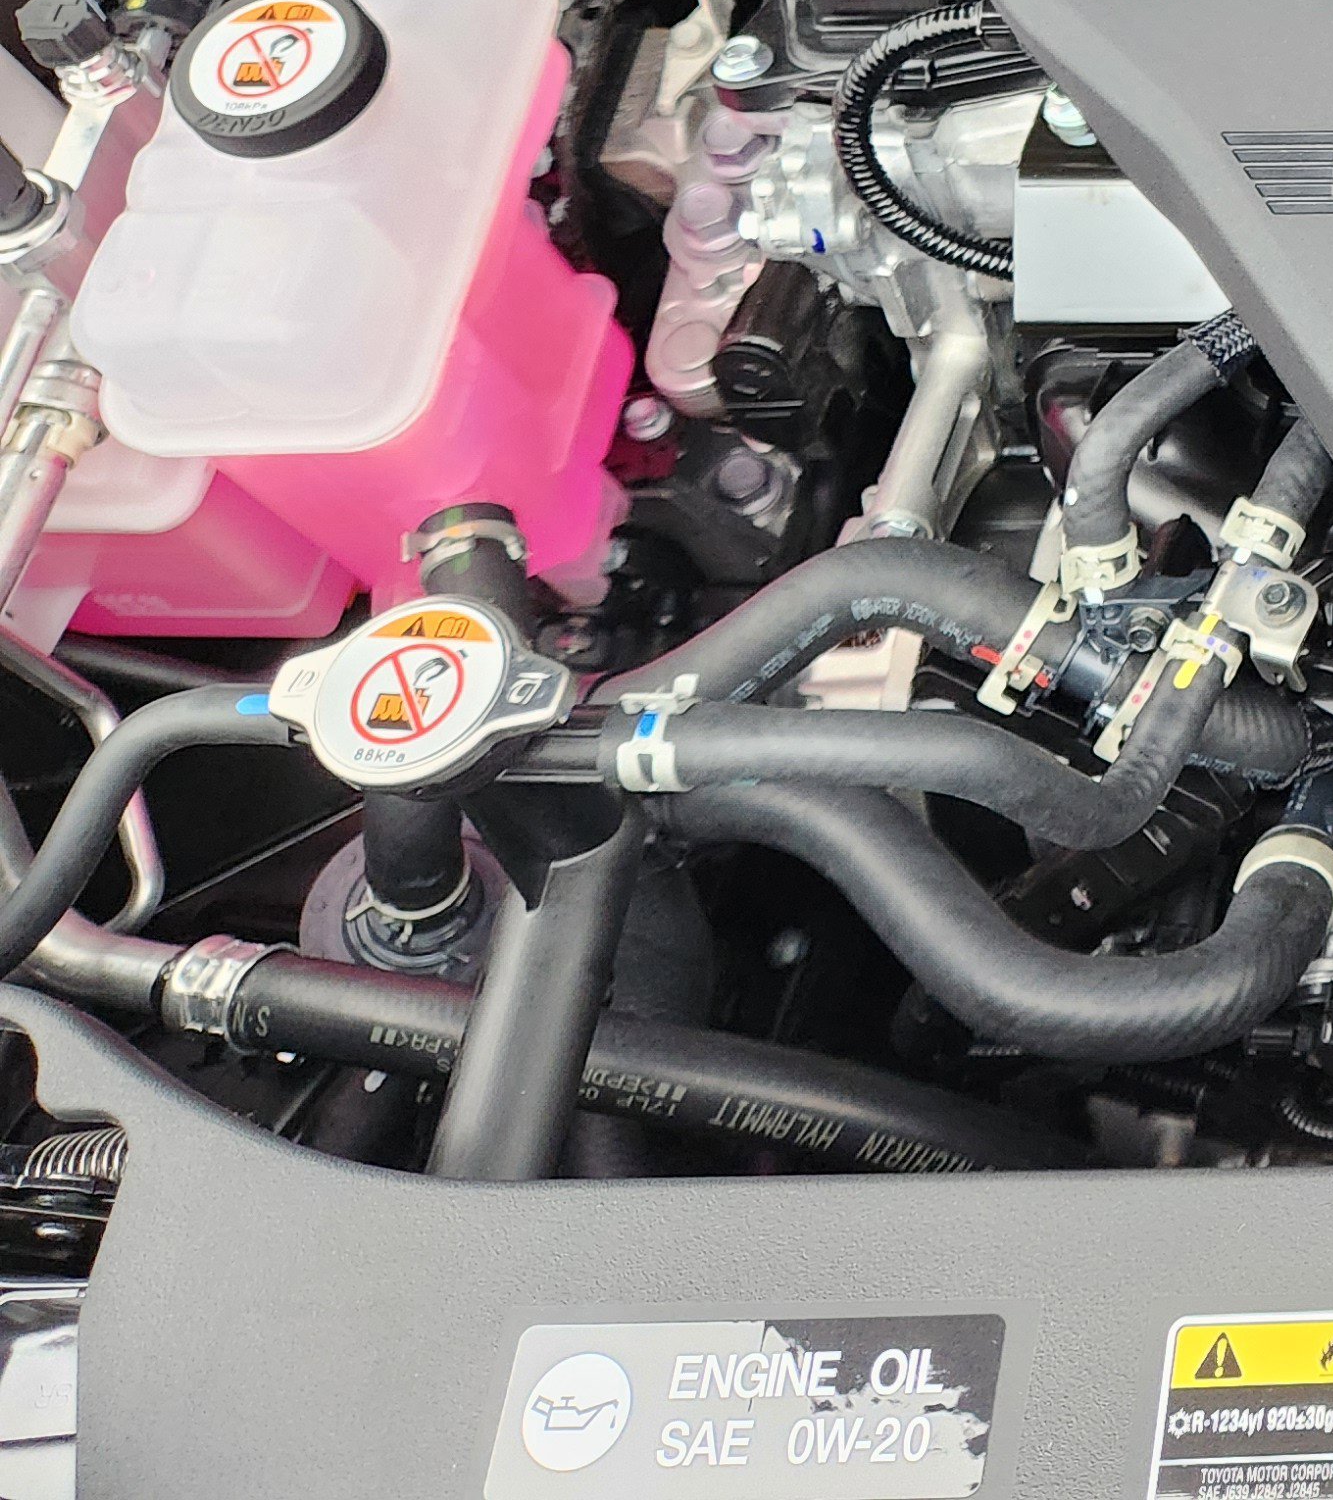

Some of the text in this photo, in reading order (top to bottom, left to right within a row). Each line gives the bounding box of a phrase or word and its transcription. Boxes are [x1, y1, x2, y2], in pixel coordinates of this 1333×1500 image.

[197, 106, 286, 134] DENSO
[353, 748, 406, 766] 88kPa
[706, 1092, 843, 1153] HYLAMMIT
[668, 1348, 944, 1400] ENGINE OIL
[656, 1415, 932, 1467] SAE 0W-20
[1200, 1467, 1243, 1484] TOYOTA
[1246, 1464, 1288, 1481] MOTOR
[1199, 1482, 1320, 1499] SAE J639 J2842 J2845
